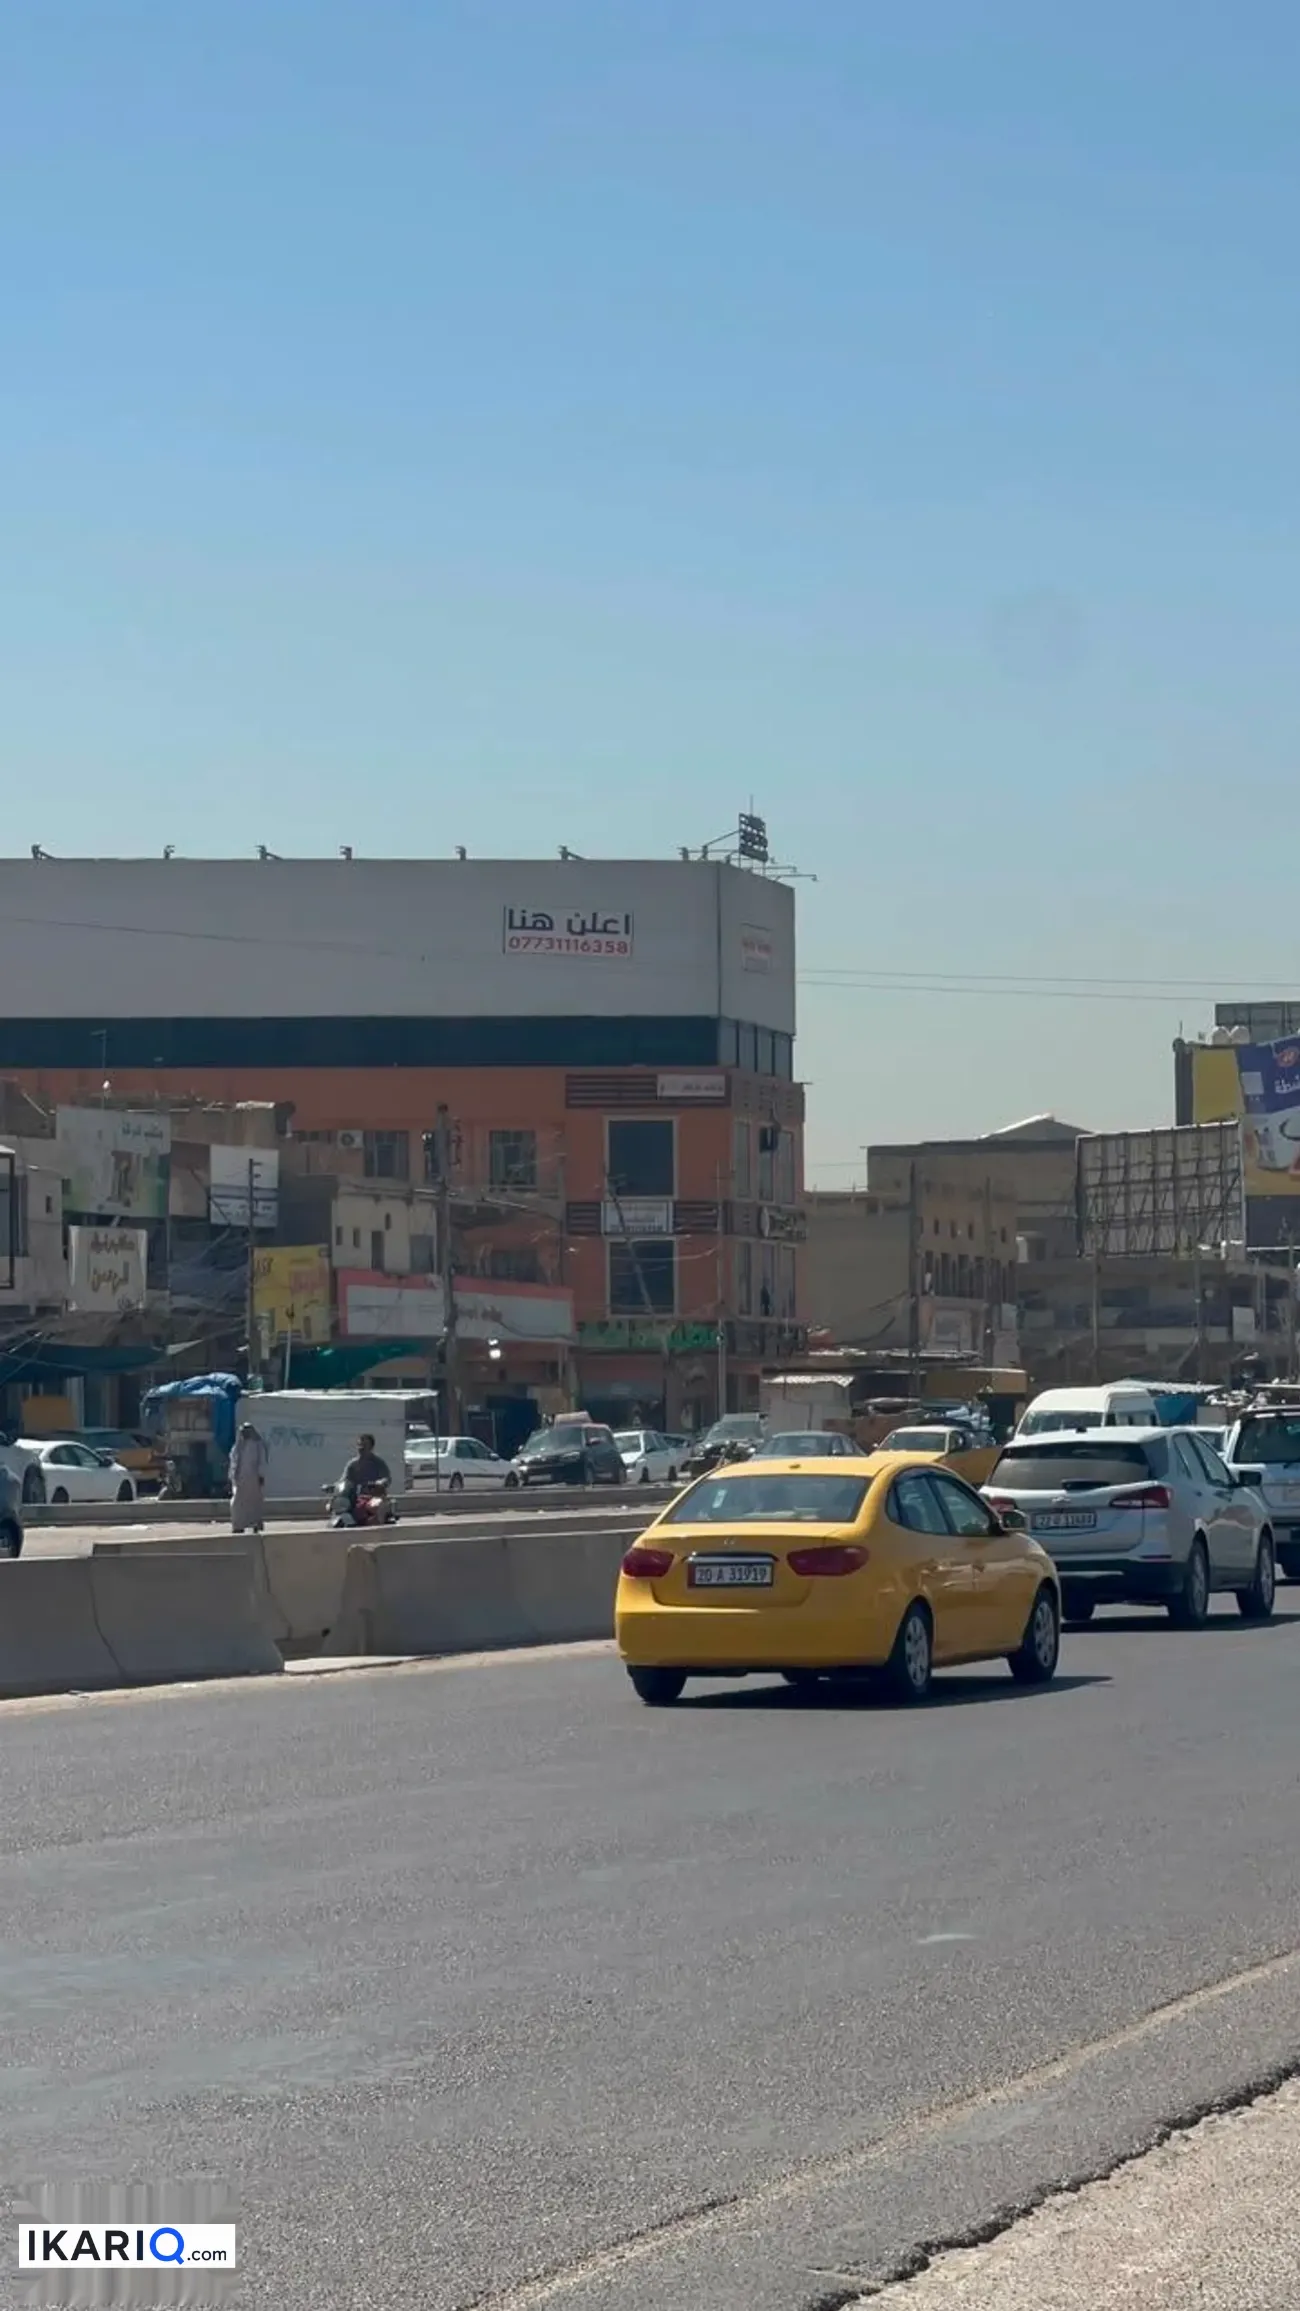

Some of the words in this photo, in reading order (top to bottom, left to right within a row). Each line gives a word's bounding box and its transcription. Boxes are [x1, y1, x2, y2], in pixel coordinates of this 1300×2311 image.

[507, 908, 554, 931] هنا
[567, 911, 630, 936] اعلن
[508, 936, 628, 955] 07731116358
[697, 1568, 713, 1582] 20
[716, 1568, 725, 1582] A
[728, 1567, 767, 1581] 31919
